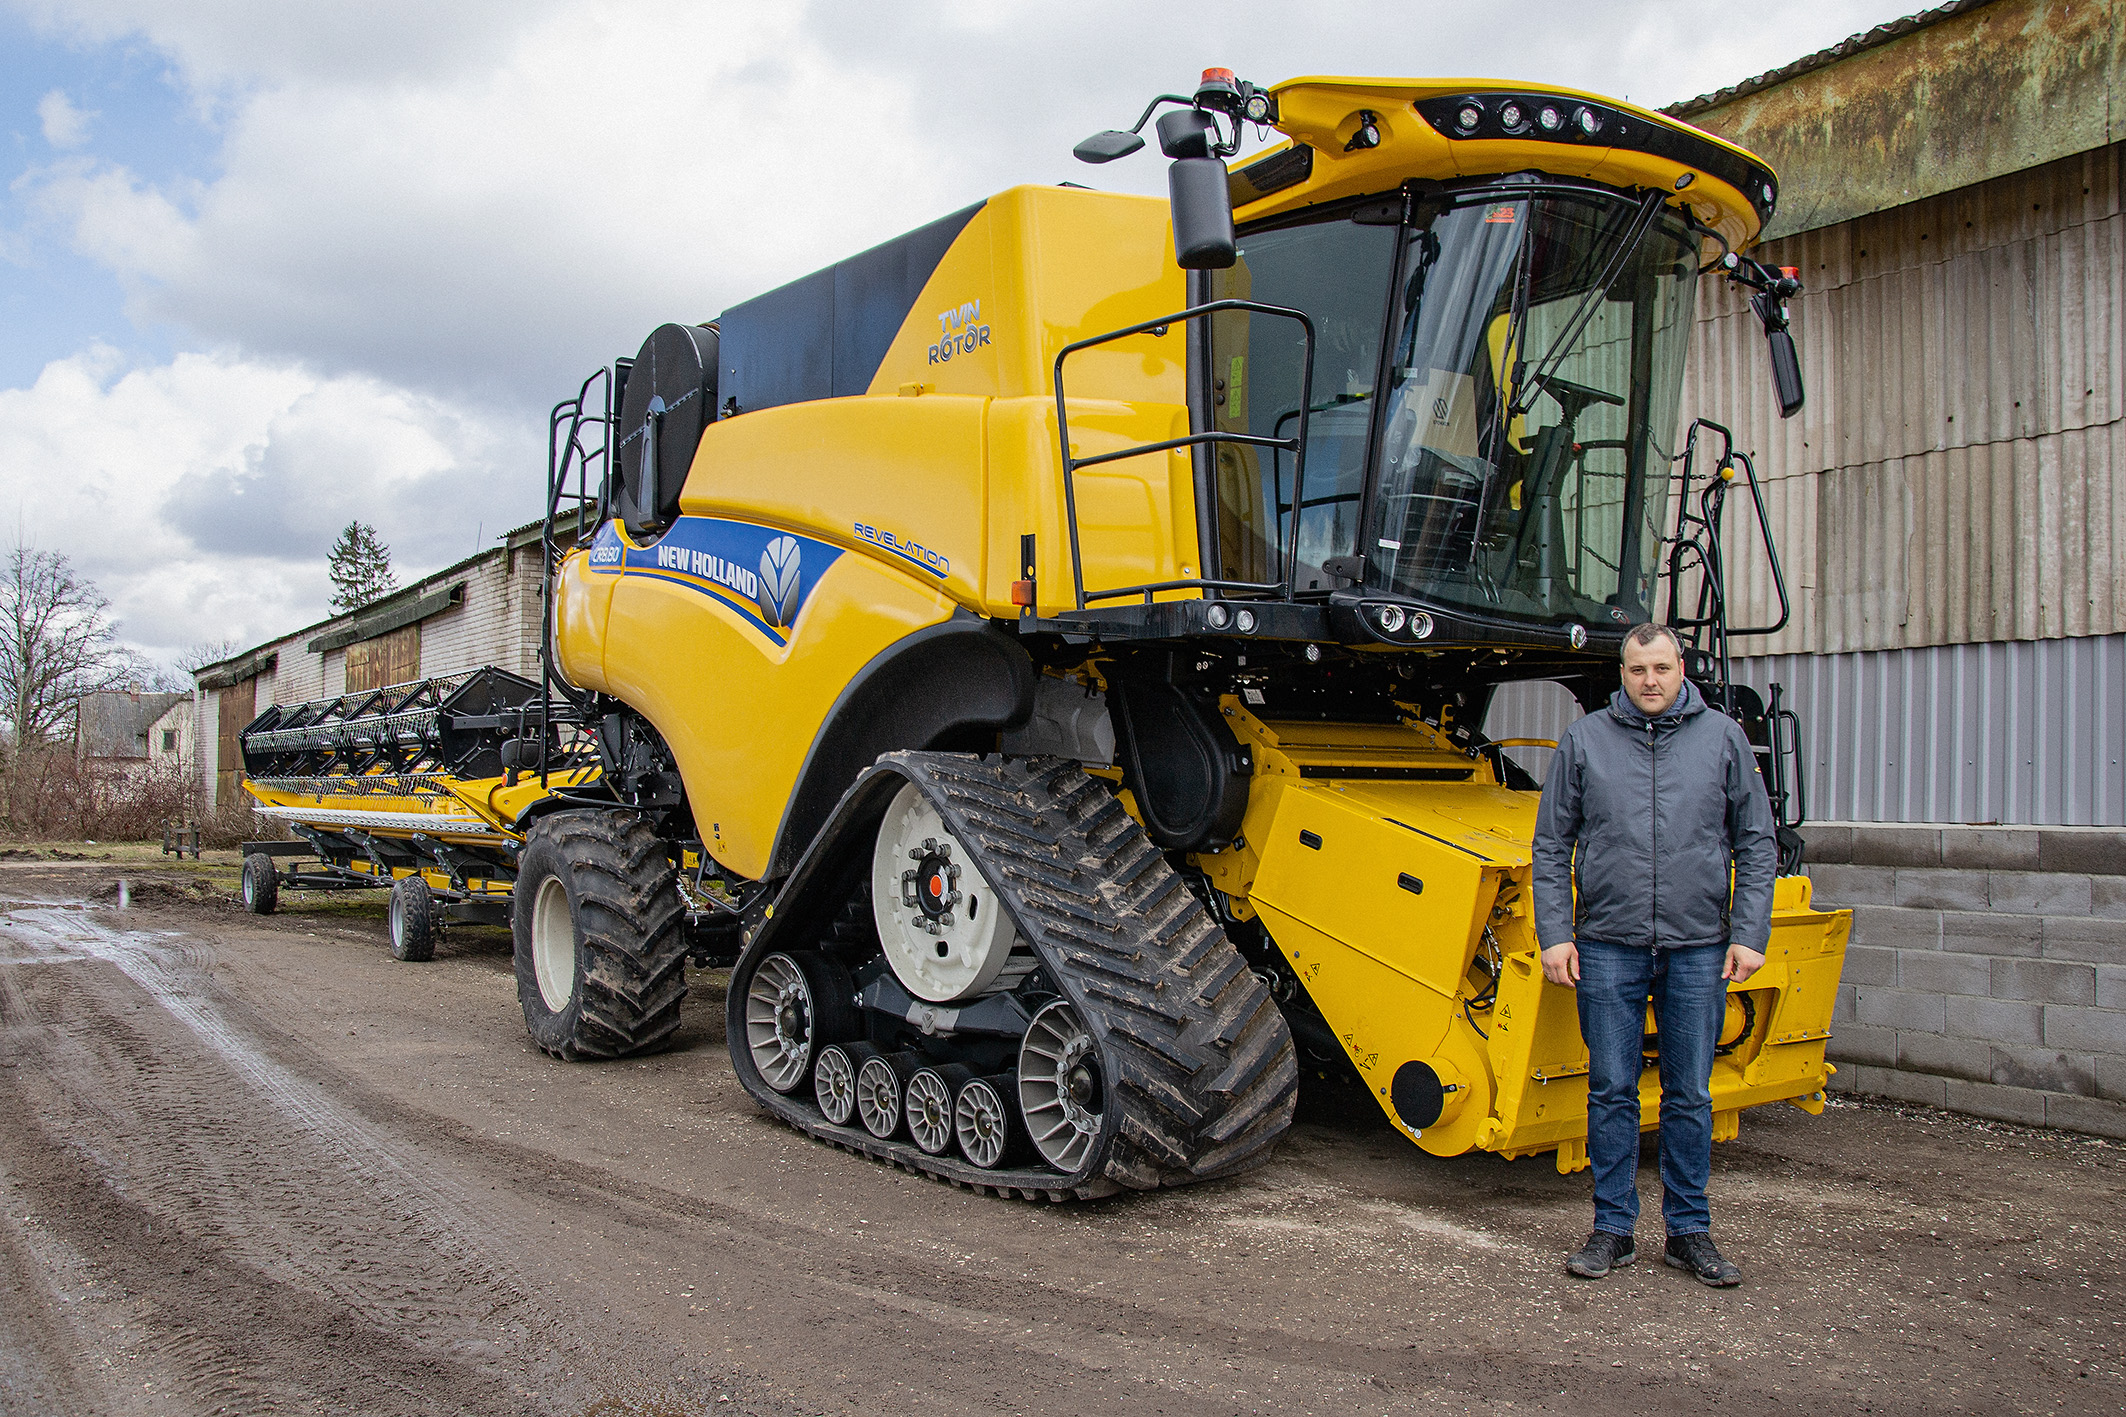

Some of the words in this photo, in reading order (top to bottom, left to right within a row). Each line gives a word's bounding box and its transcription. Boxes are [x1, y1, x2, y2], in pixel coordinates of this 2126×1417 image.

[938, 298, 981, 333] TWIN
[928, 323, 992, 366] ROTOR
[854, 521, 950, 572] REVELATION
[657, 544, 691, 572] NEW
[691, 549, 758, 600] HOLLAND
